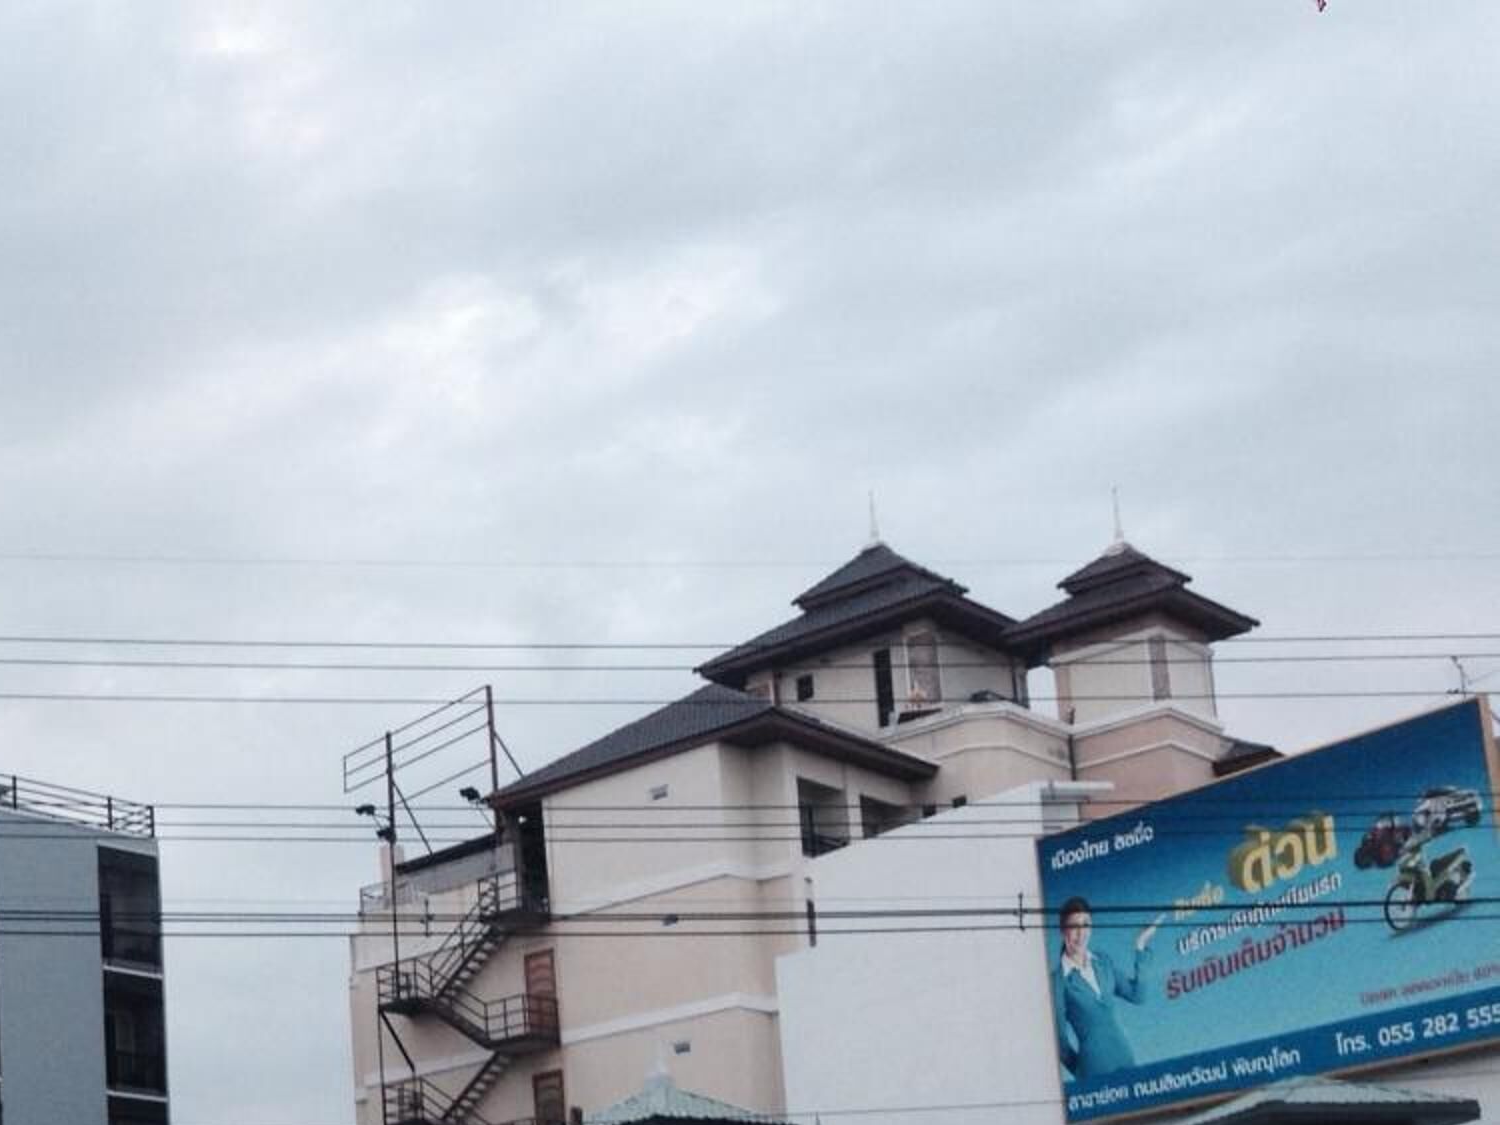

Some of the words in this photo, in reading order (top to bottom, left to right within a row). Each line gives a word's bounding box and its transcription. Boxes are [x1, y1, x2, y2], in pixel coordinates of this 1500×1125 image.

[1230, 812, 1338, 893] ด่วน
[1378, 1021, 1415, 1047] 055
[1421, 1012, 1461, 1039] 282
